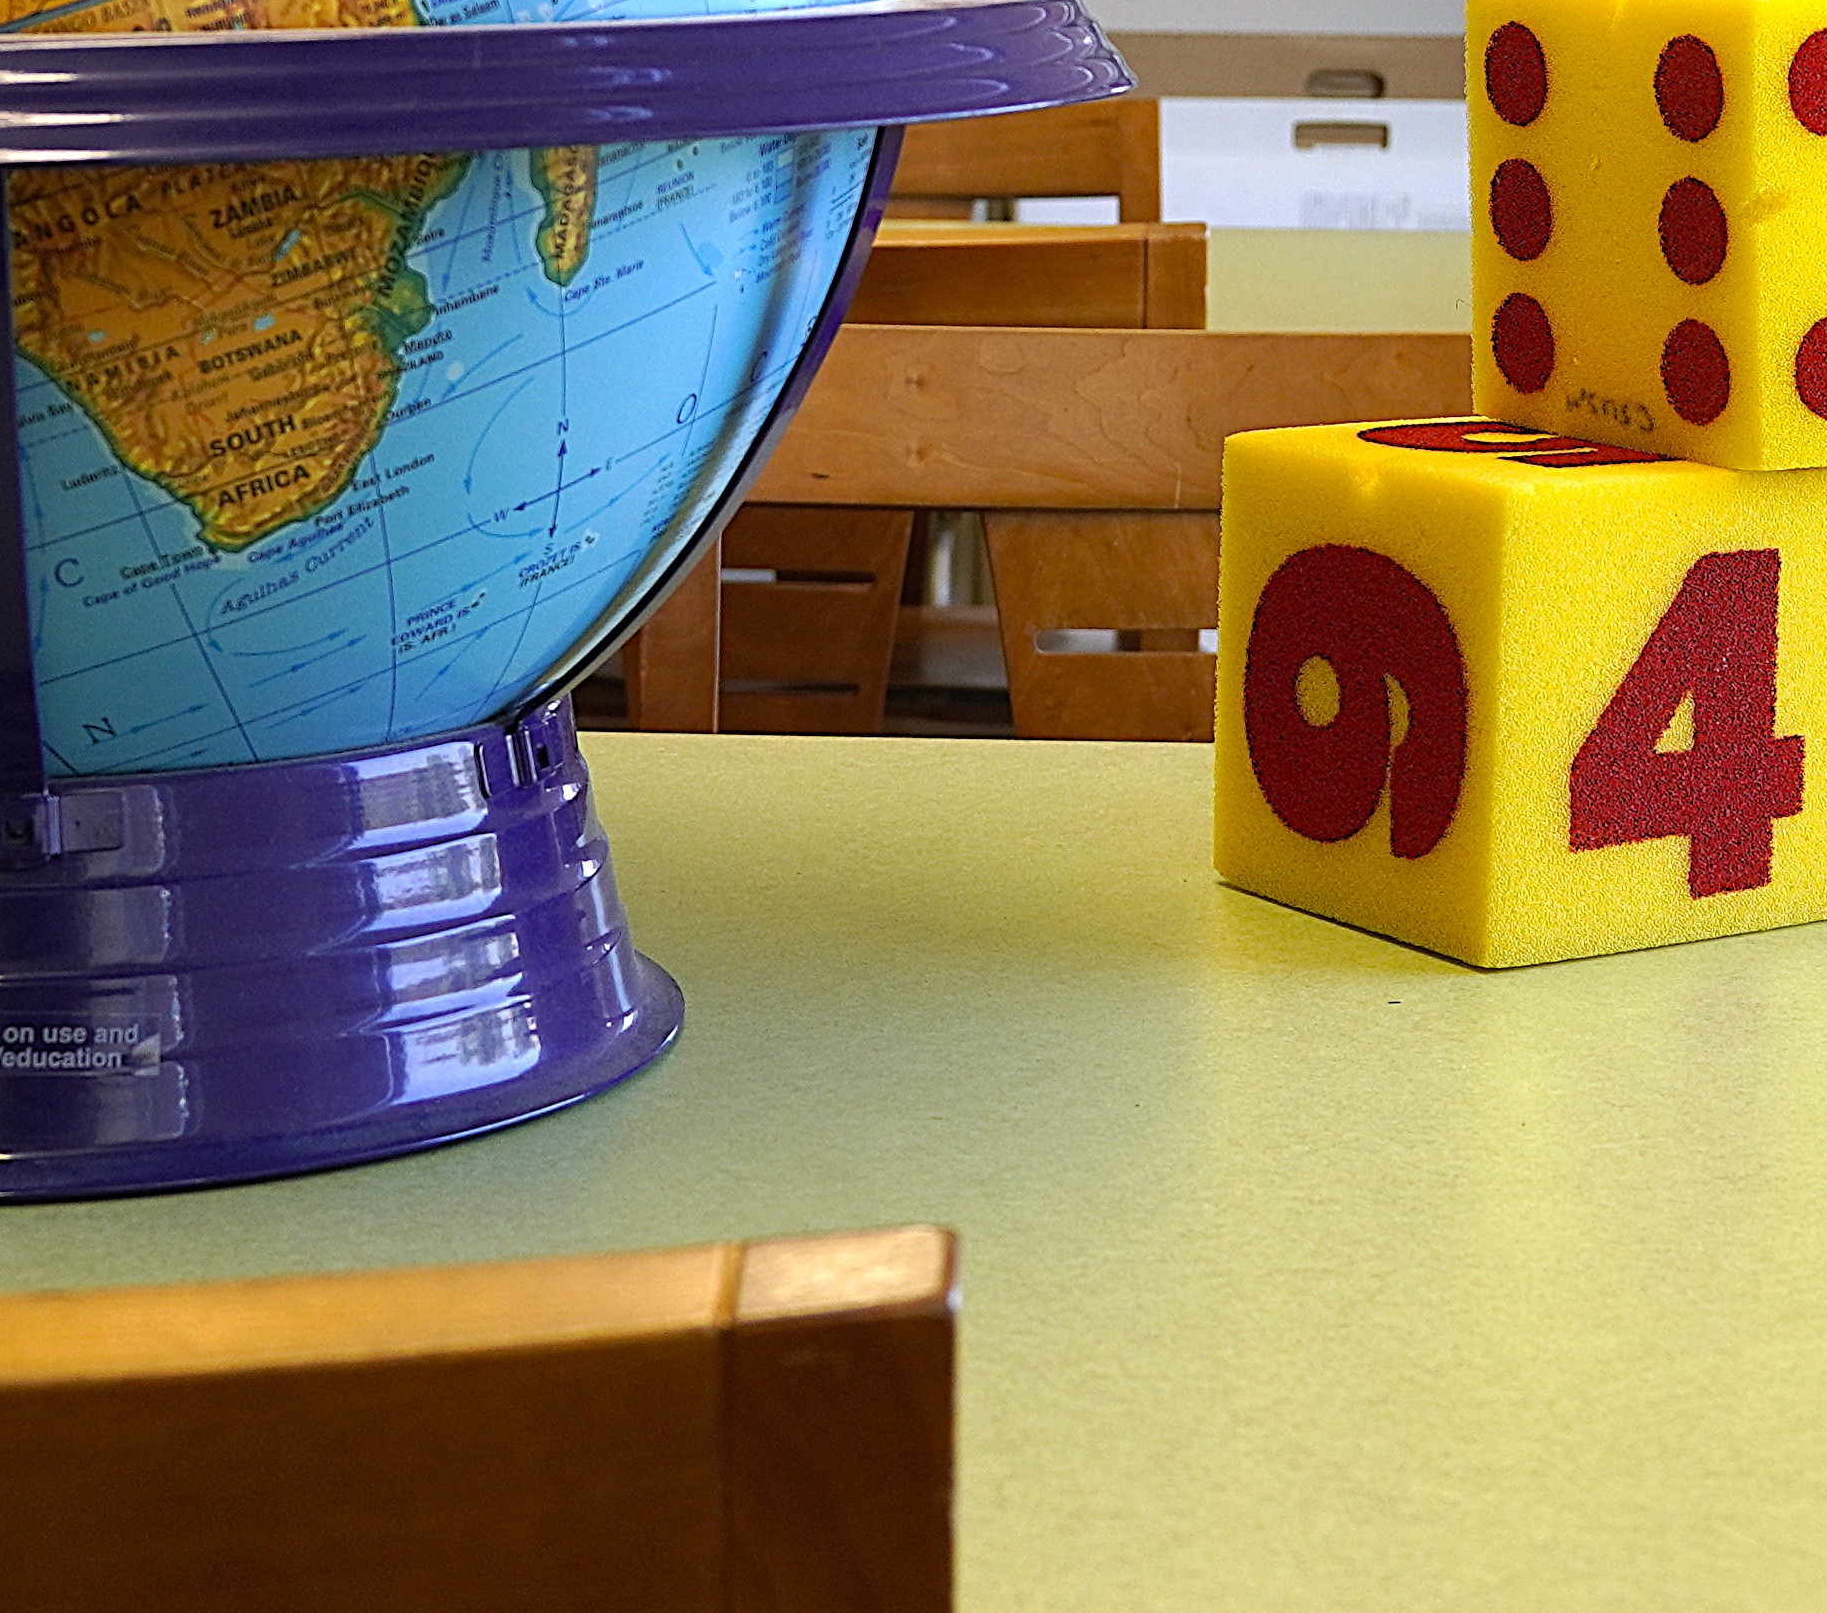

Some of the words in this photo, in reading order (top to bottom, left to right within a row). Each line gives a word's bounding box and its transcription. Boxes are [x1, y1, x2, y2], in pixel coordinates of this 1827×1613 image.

[210, 186, 300, 229] ZAMBIA
[200, 328, 304, 375] BOTSWANA
[210, 413, 297, 459] SOUTH
[557, 417, 571, 435] N
[385, 450, 436, 477] London
[218, 463, 312, 510] AFRICA
[346, 484, 411, 519] Elizabeth
[82, 589, 120, 608] Cape
[183, 553, 224, 580] Hope
[220, 566, 301, 617] Agulhas
[304, 515, 376, 574] Current
[406, 598, 457, 627] PRINCE
[1569, 547, 1805, 898] 4
[3, 1025, 35, 1044] on
[42, 1026, 88, 1045] use
[94, 1023, 140, 1045] and
